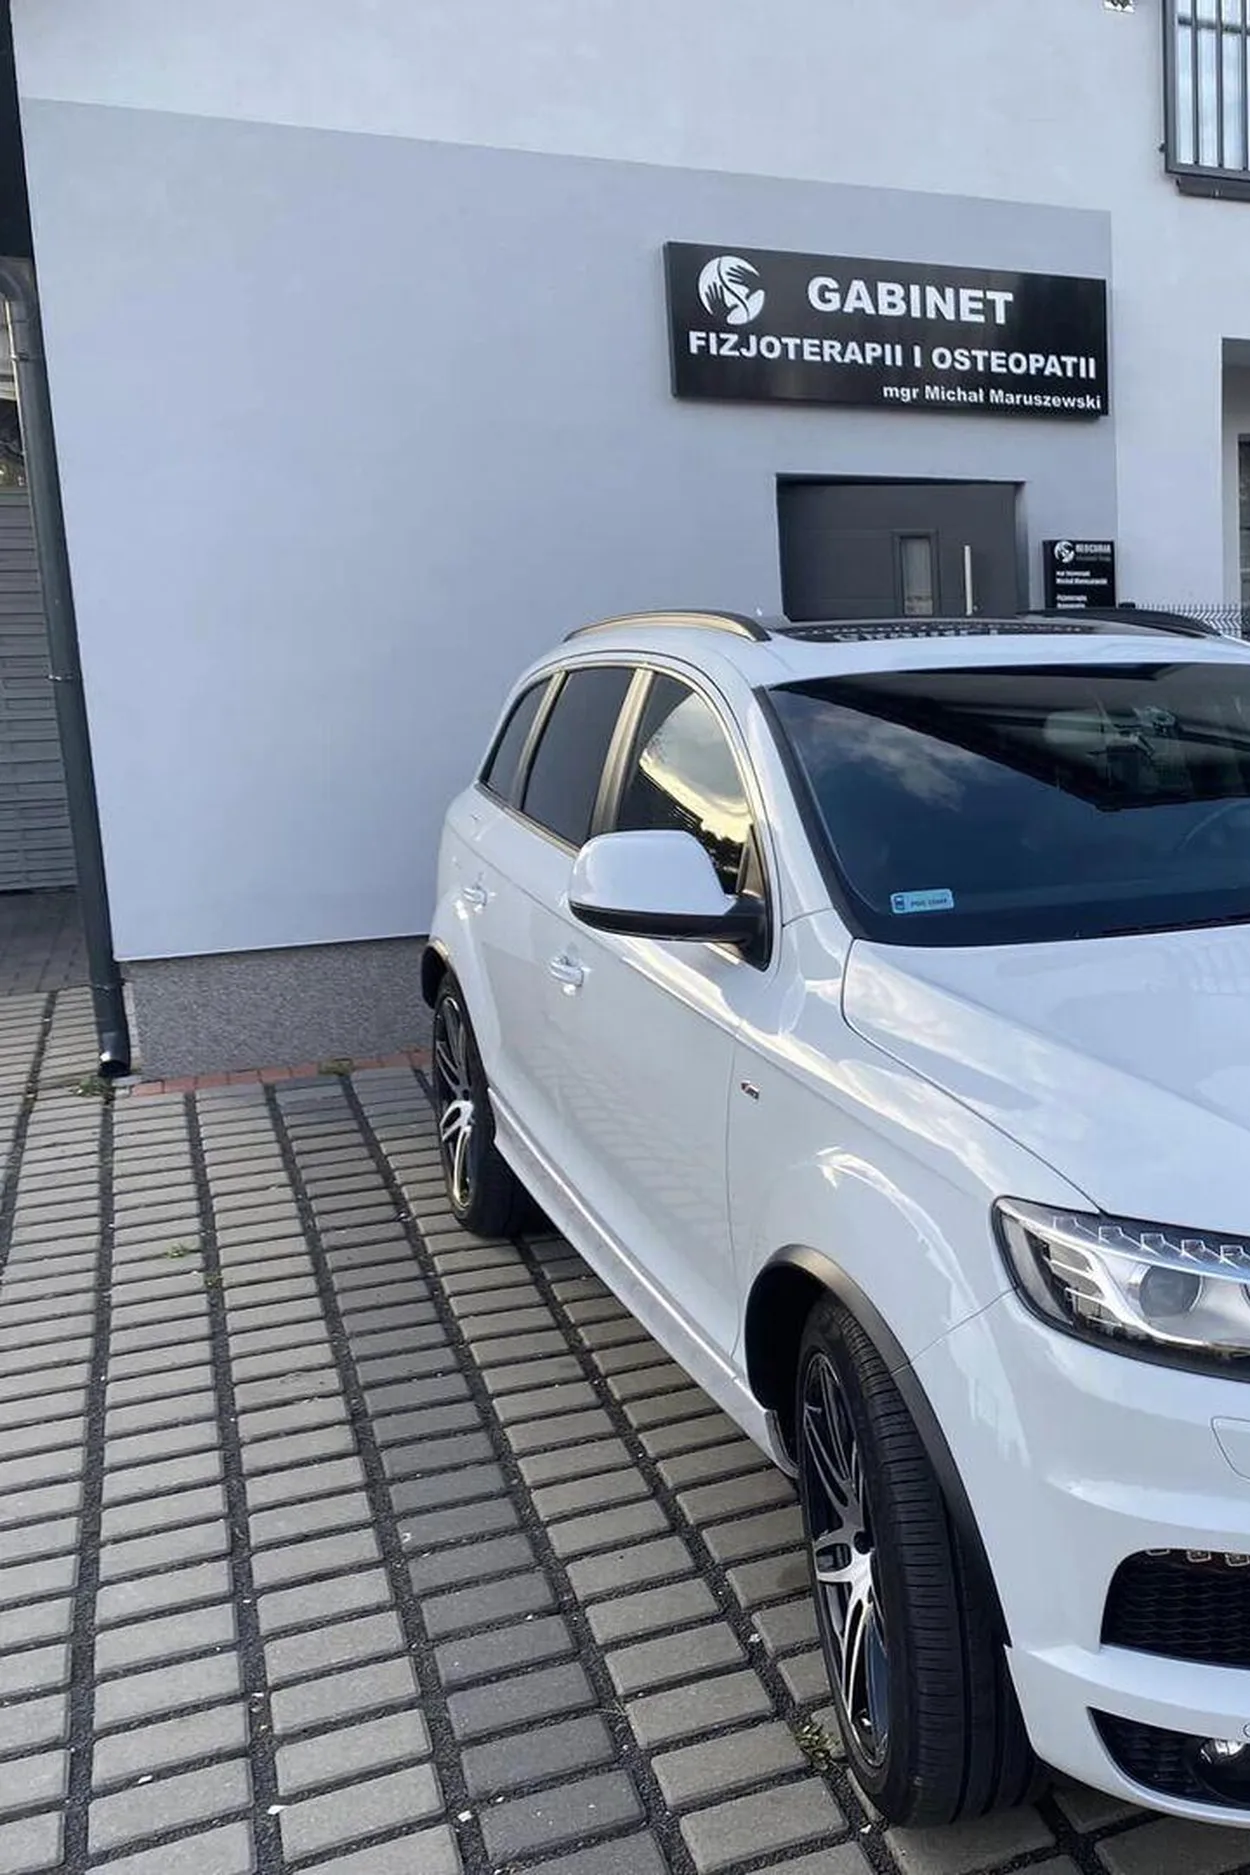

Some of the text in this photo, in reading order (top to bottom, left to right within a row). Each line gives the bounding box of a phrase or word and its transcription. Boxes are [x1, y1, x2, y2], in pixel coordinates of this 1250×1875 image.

[807, 275, 1013, 325] GABINET
[689, 331, 1096, 379] FIZJOTERAPII I OSTEOPATII
[883, 386, 920, 403] mgr
[989, 391, 1102, 410] Maruszewski
